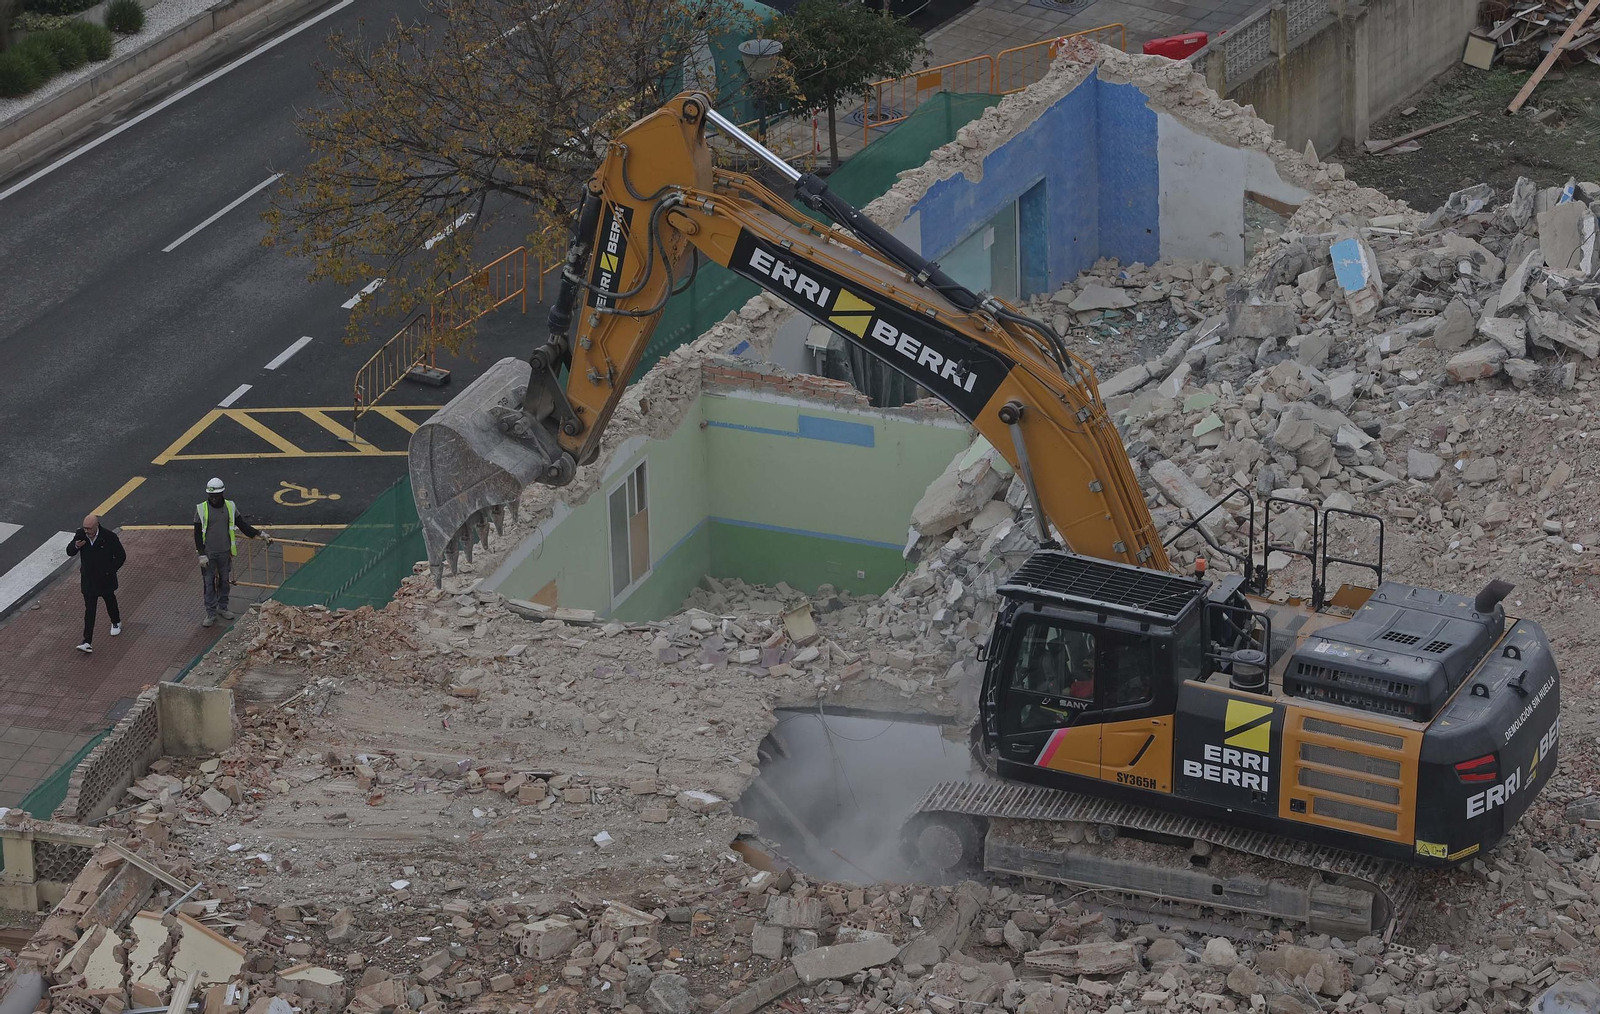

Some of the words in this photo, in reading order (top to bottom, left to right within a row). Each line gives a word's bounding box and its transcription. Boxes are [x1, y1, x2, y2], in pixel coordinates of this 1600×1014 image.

[749, 247, 832, 308] ERRI
[870, 318, 978, 393] BERRI
[1059, 699, 1089, 710] SANY
[1531, 694, 1541, 709] SIN
[1537, 675, 1556, 700] HUELLA
[1204, 743, 1270, 773] ERRI
[1116, 771, 1157, 790] SY365H
[1183, 759, 1269, 793] BERRI
[1467, 765, 1521, 820] ERRI
